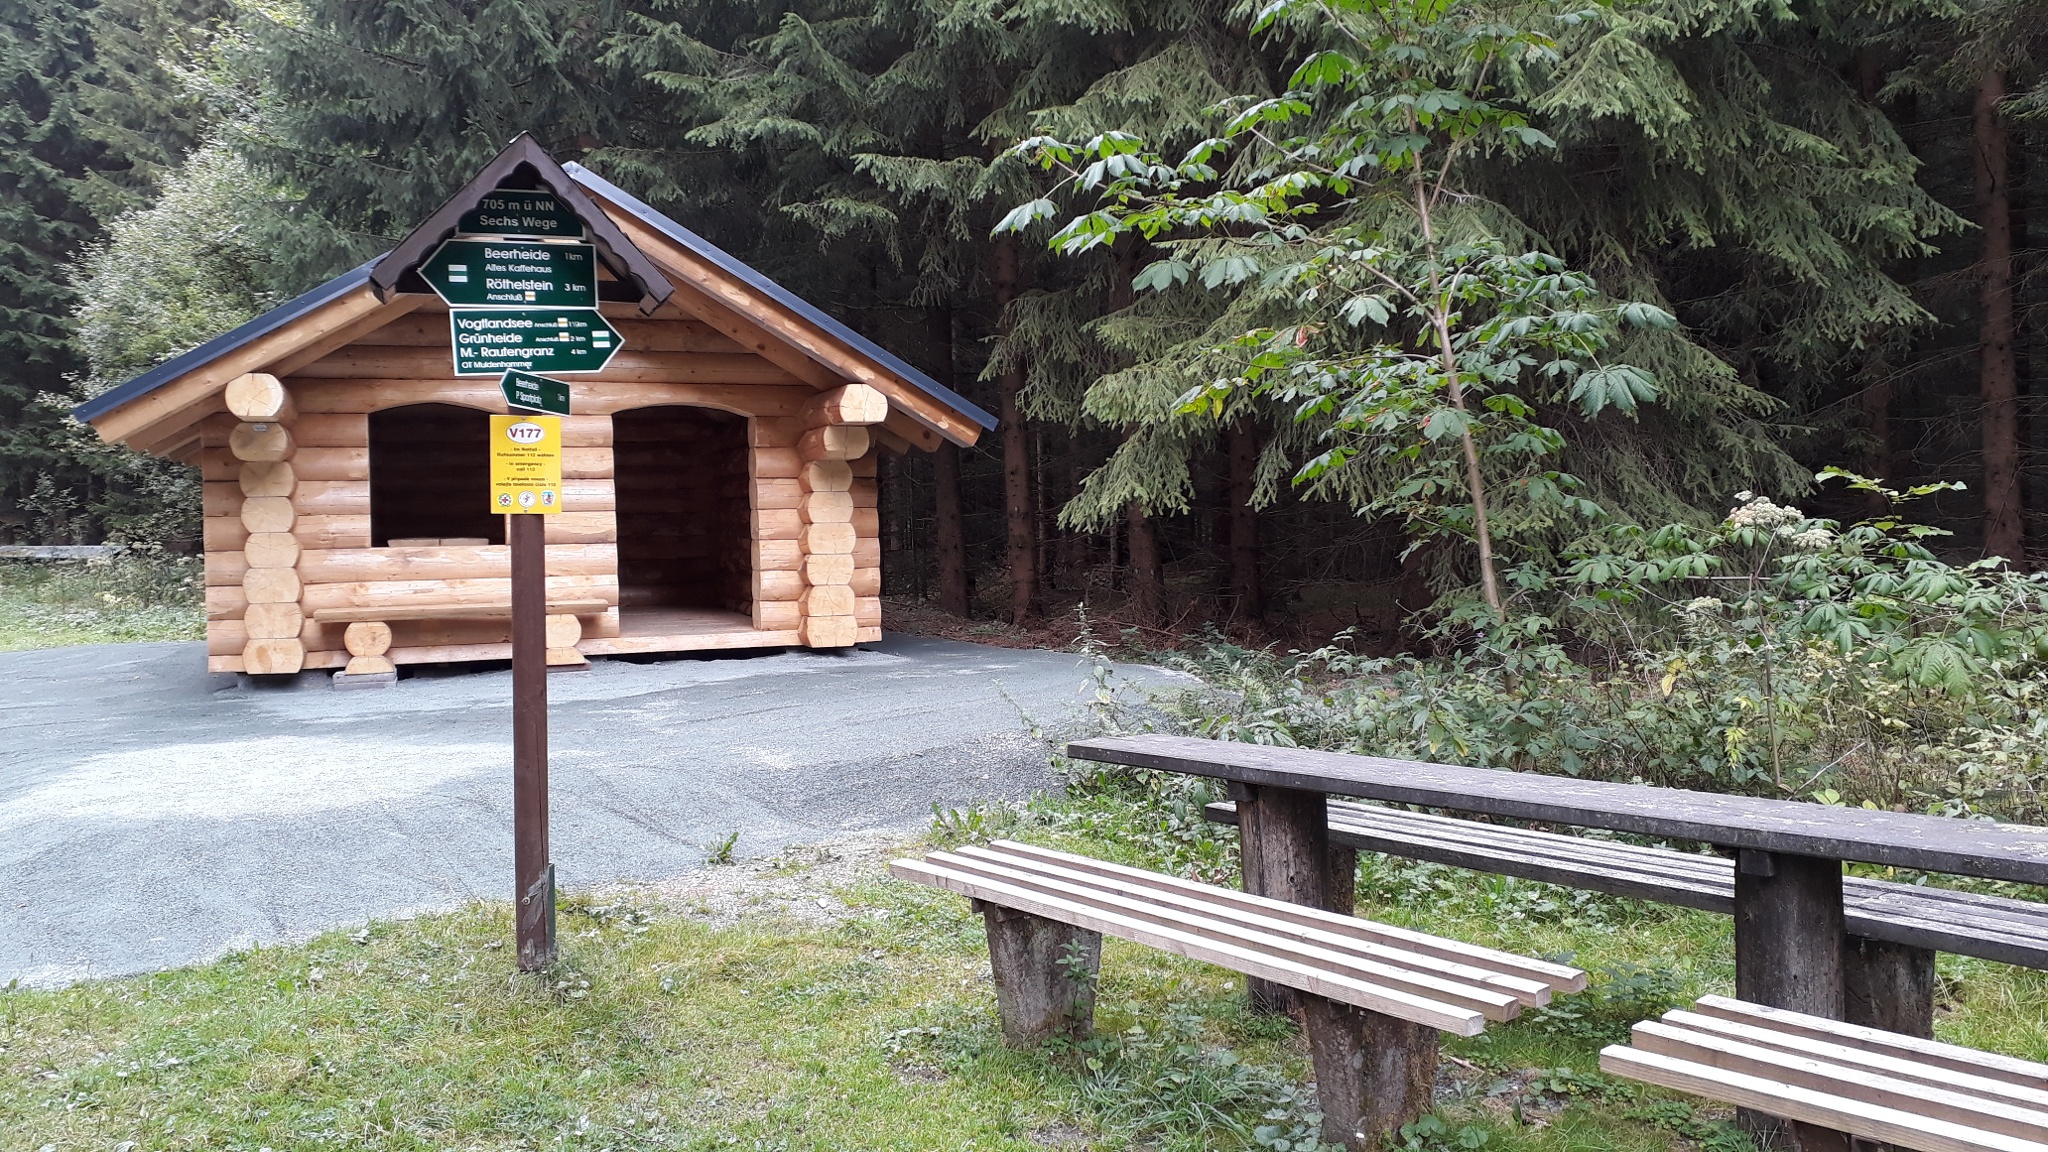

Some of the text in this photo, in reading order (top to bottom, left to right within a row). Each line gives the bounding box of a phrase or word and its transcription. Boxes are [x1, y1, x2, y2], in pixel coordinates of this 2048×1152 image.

[482, 199, 555, 211] 705 m ü NN
[479, 215, 558, 230] Sechs Wege
[484, 247, 551, 261] Beerheide
[486, 278, 586, 292] Röthelstein 3 km
[486, 293, 523, 301] Anschluß
[457, 318, 533, 331] Vogtlandsee
[458, 332, 523, 344] Grünheide
[480, 347, 555, 358] Rautengranz
[473, 361, 533, 369] Muldenhammer
[515, 390, 520, 400] P
[509, 428, 542, 438] V177
